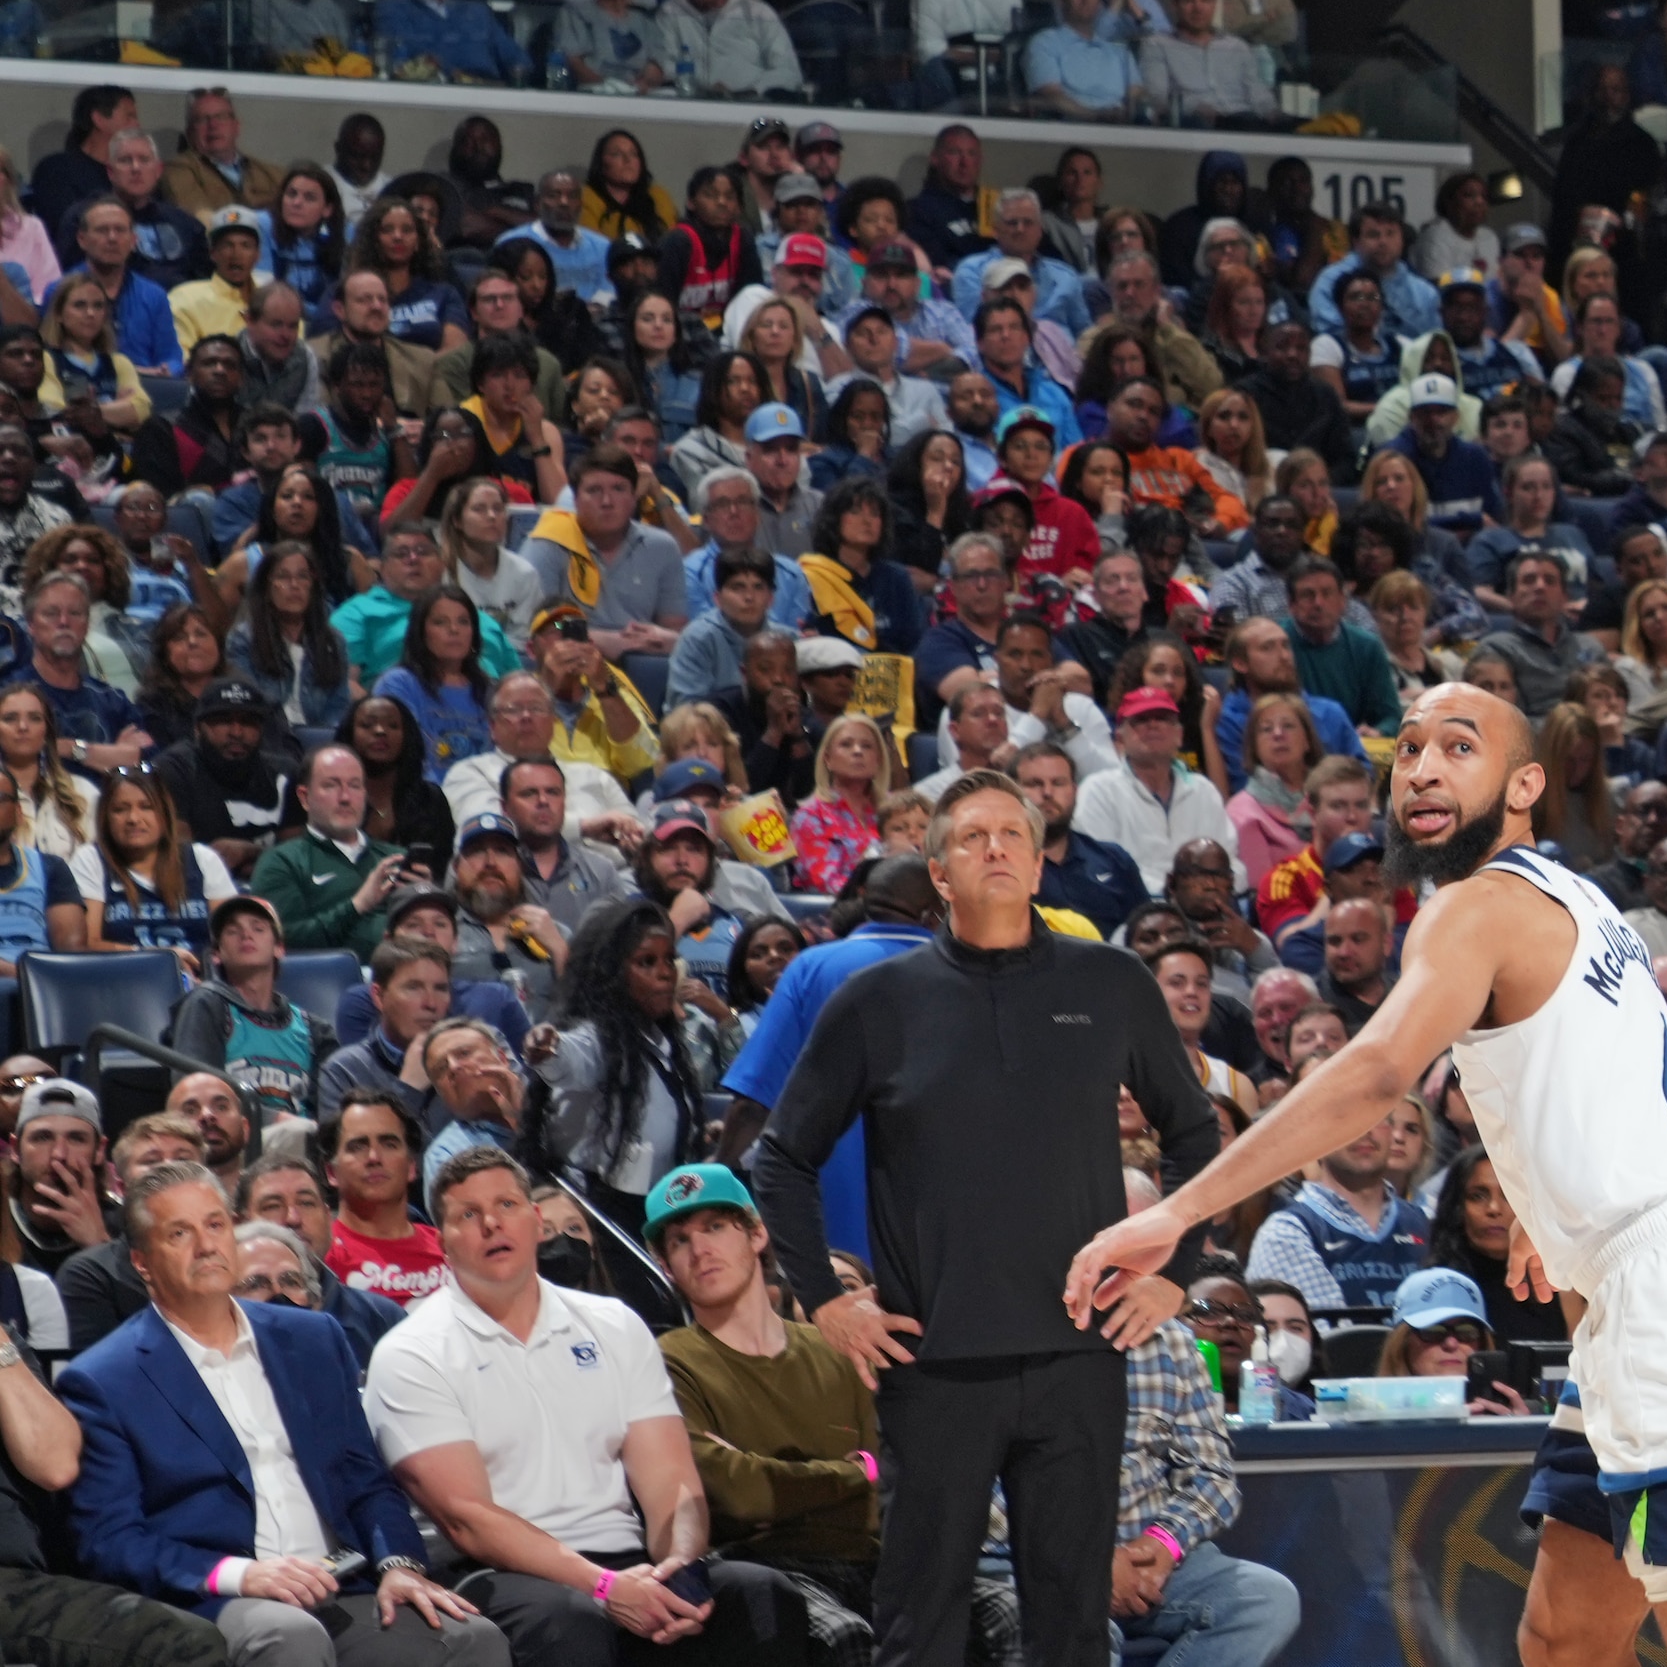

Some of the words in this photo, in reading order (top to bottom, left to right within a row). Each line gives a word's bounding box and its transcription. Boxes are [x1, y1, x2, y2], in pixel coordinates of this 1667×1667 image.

[105, 898, 208, 921] GRZZIES
[1051, 1013, 1093, 1025] WOLVES
[346, 1259, 455, 1299] Memph
[1331, 1260, 1421, 1282] GRIZZLIE
